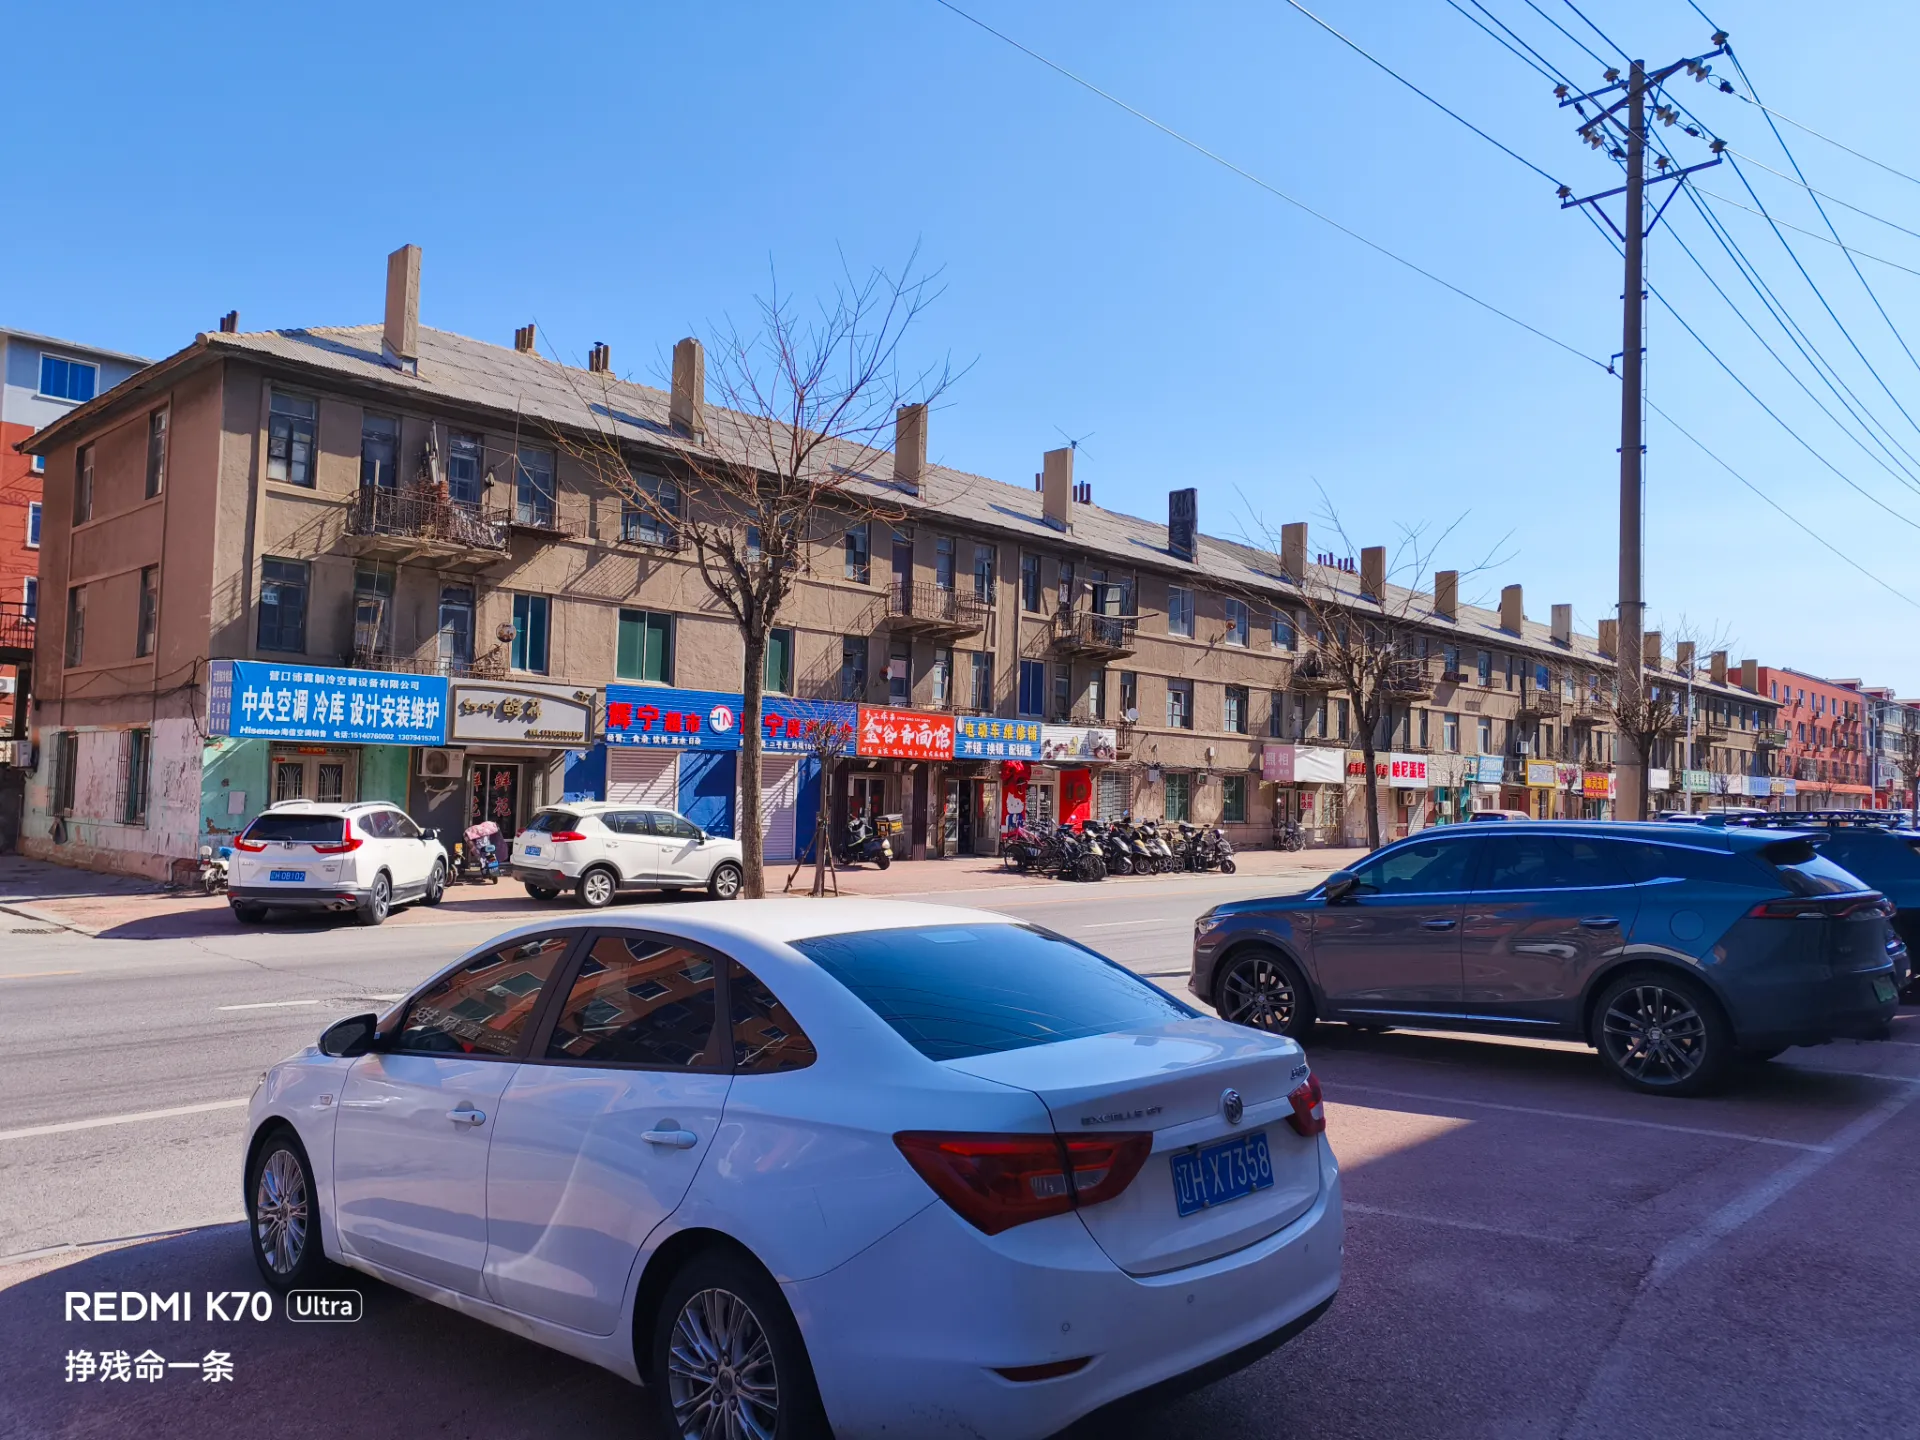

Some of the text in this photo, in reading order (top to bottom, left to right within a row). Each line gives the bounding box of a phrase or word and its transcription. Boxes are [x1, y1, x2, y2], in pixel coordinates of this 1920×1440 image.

[241, 684, 440, 730] 中央空调 冷库 设计安装维护
[239, 725, 281, 736] Hisense
[964, 721, 1038, 742] 电动车维修铺
[964, 740, 982, 755] 开锁
[1265, 752, 1289, 766] 照相
[1391, 760, 1427, 779] 哈尼蛋糕
[493, 771, 512, 817] 鲜花
[1081, 1108, 1144, 1126] EXCELLE
